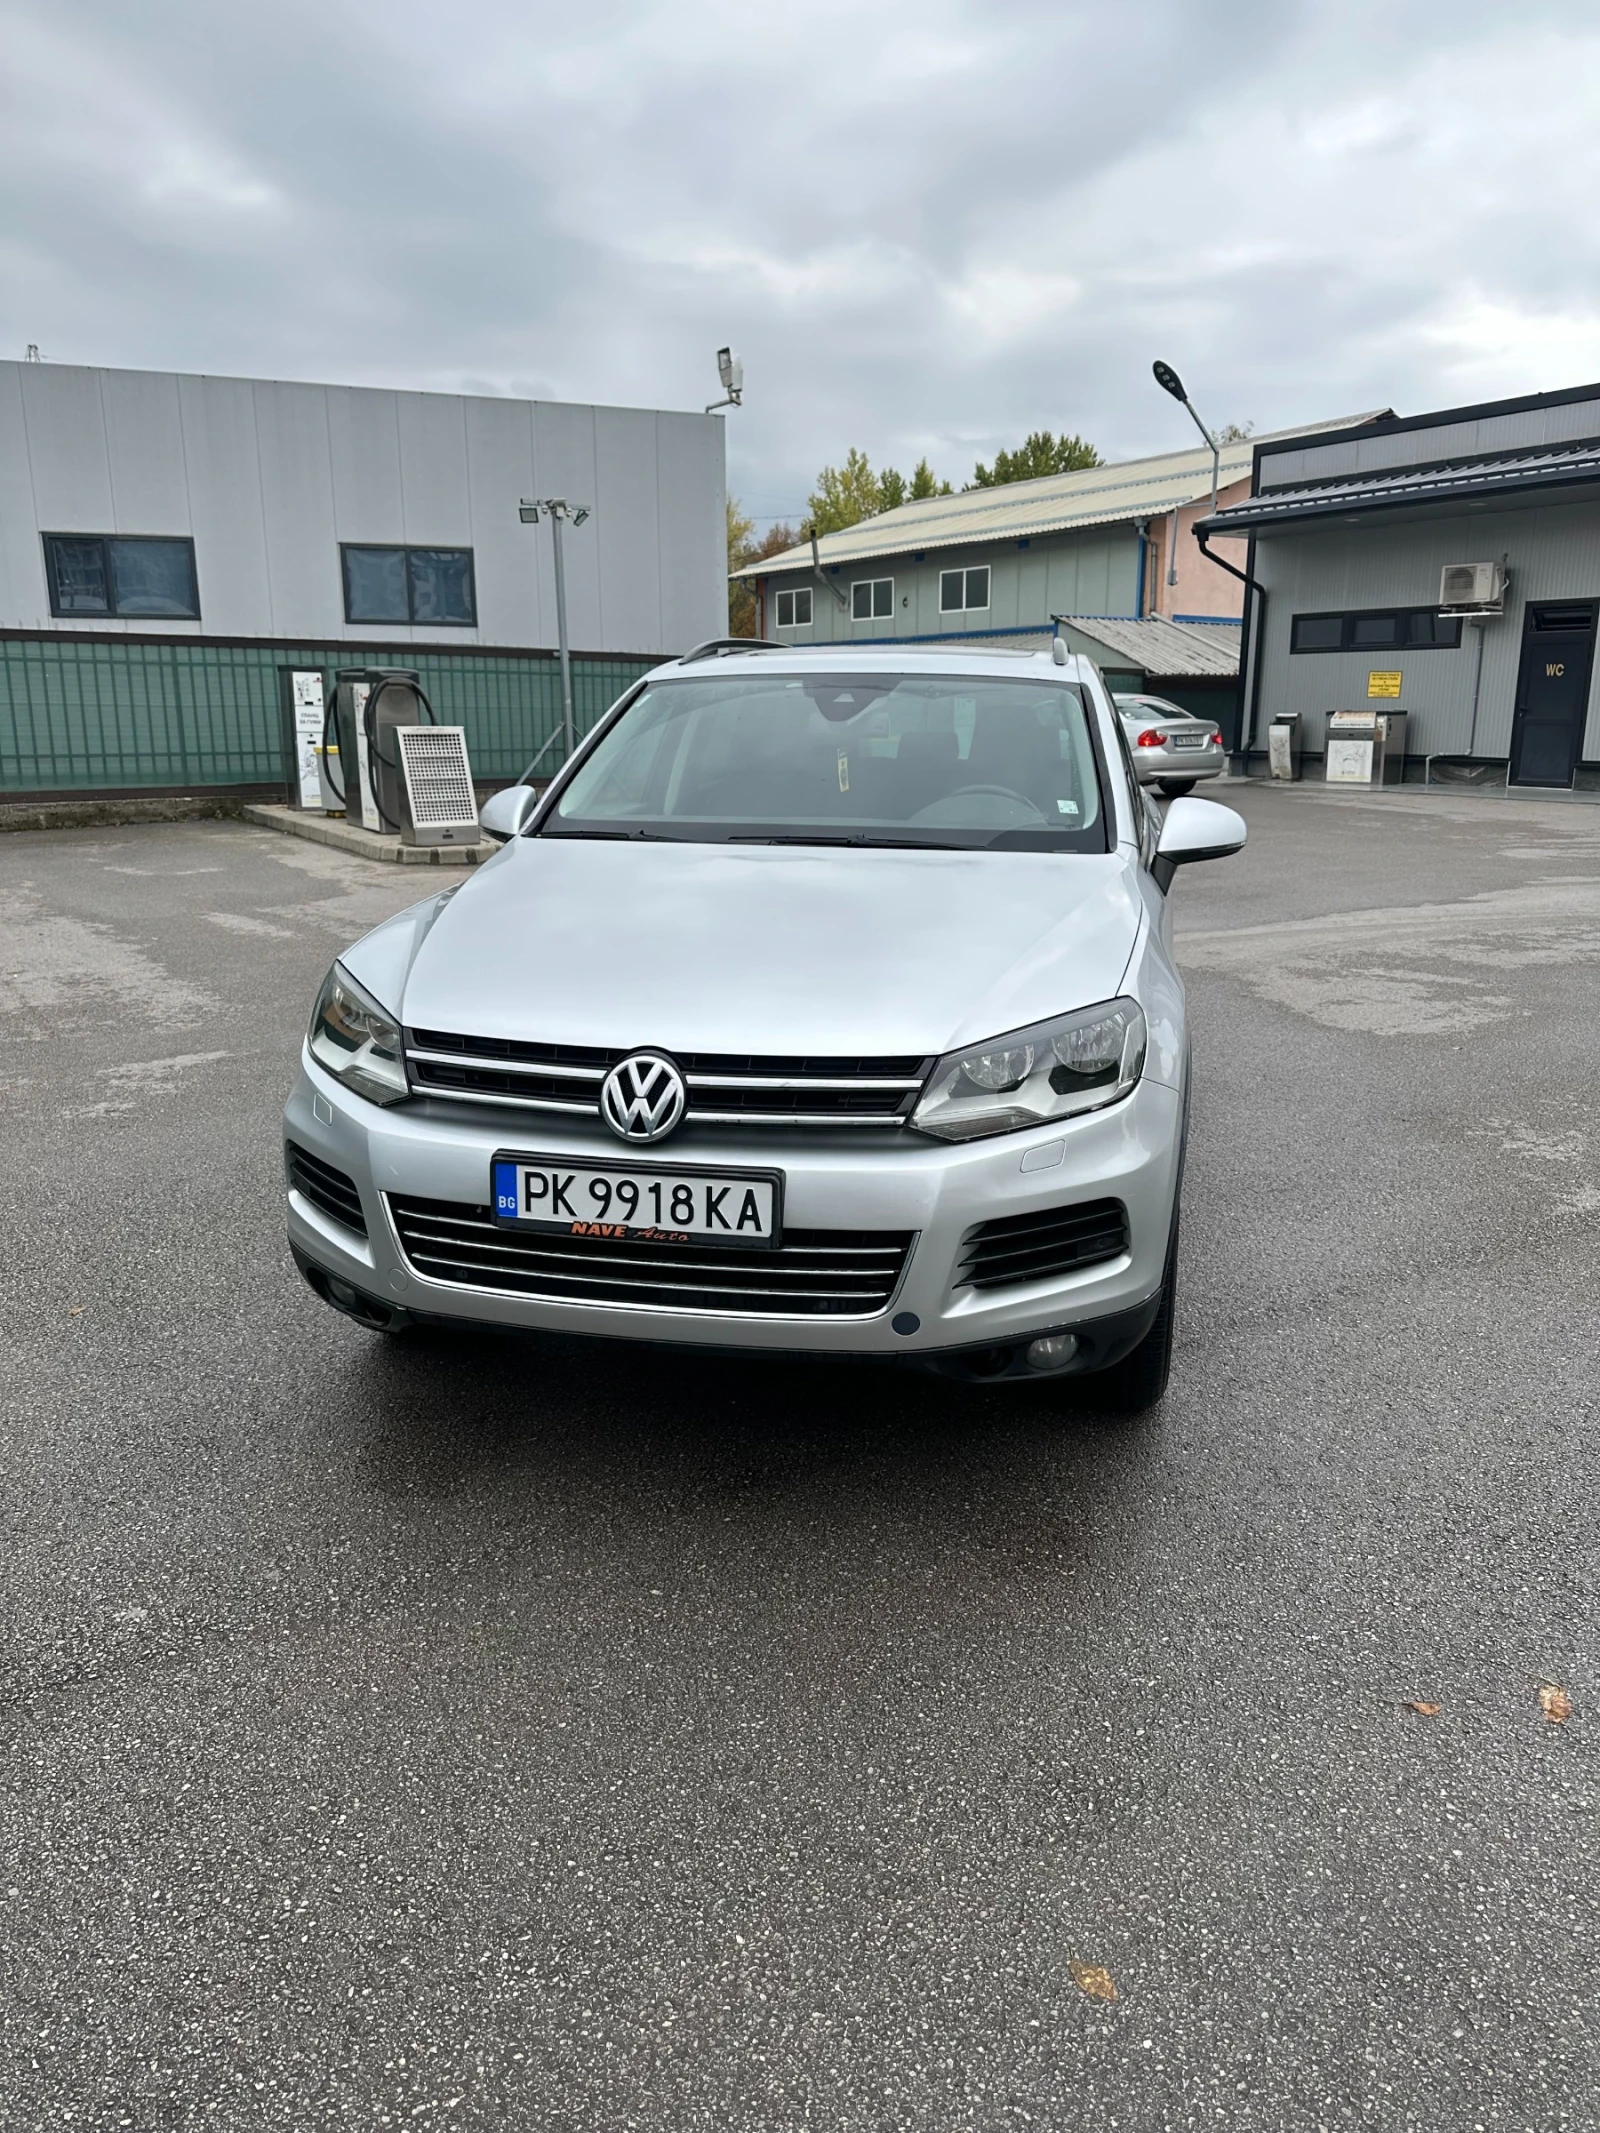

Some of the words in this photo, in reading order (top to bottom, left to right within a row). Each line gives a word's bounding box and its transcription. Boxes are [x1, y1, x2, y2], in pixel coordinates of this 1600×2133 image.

[1546, 663, 1565, 676] WC
[498, 1195, 516, 1210] BG
[524, 1171, 578, 1217] PK
[588, 1177, 695, 1226] 9918
[706, 1186, 763, 1233] KA
[571, 1221, 627, 1238] NAVE
[633, 1226, 690, 1242] Auto
